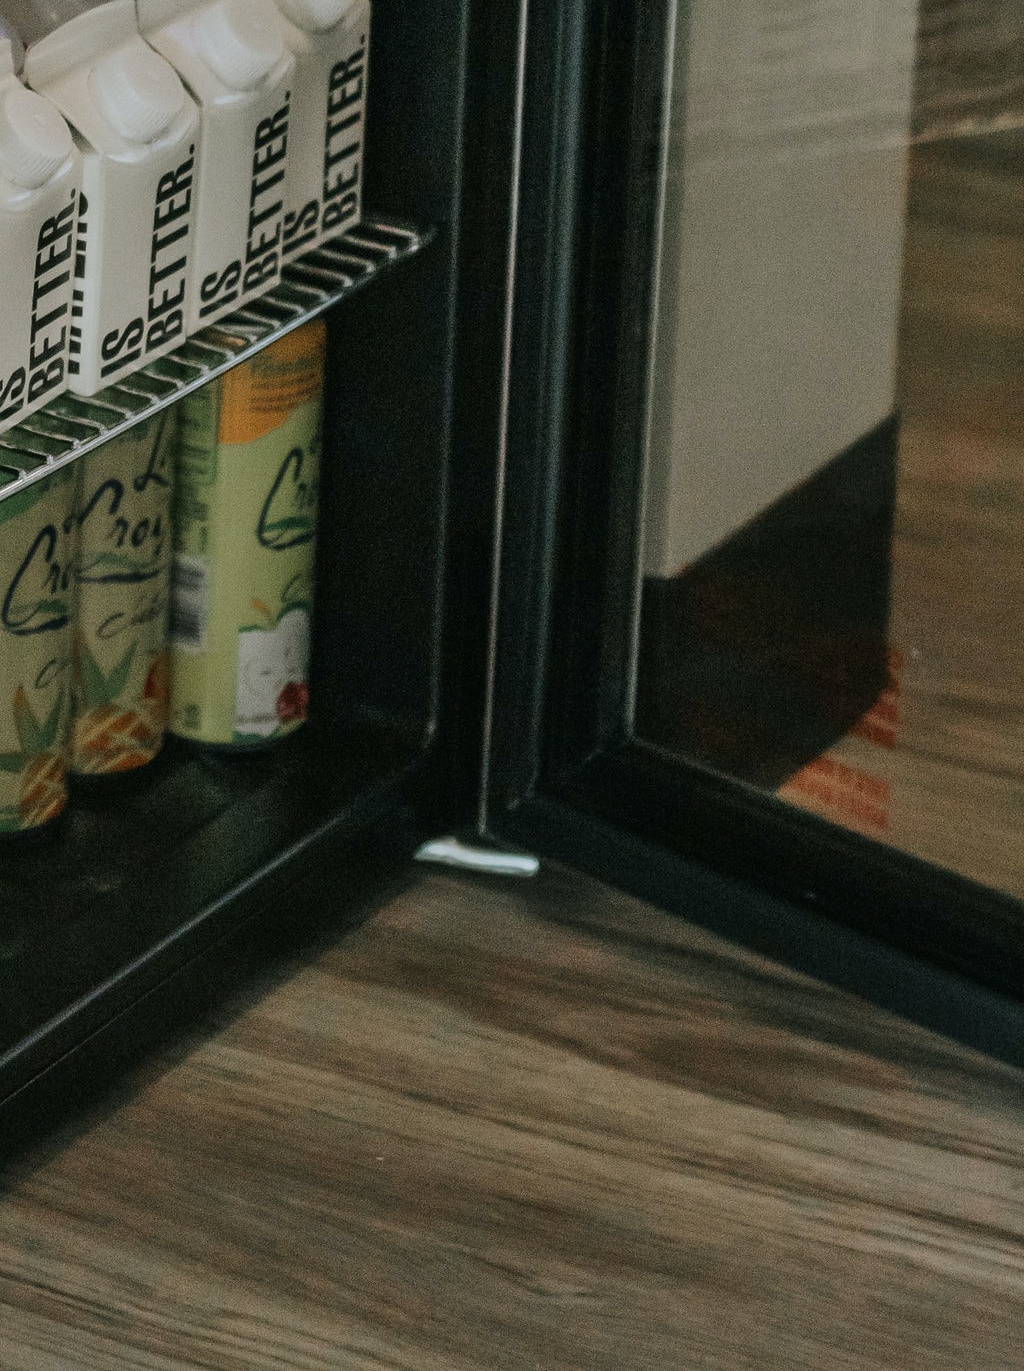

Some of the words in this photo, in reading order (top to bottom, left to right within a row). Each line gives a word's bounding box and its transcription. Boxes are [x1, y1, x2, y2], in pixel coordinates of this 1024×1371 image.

[322, 33, 366, 231] BETTER.
[27, 188, 76, 404] BETTER.
[100, 316, 145, 379] IS
[145, 143, 195, 354] BETTER.
[198, 260, 242, 318] IS
